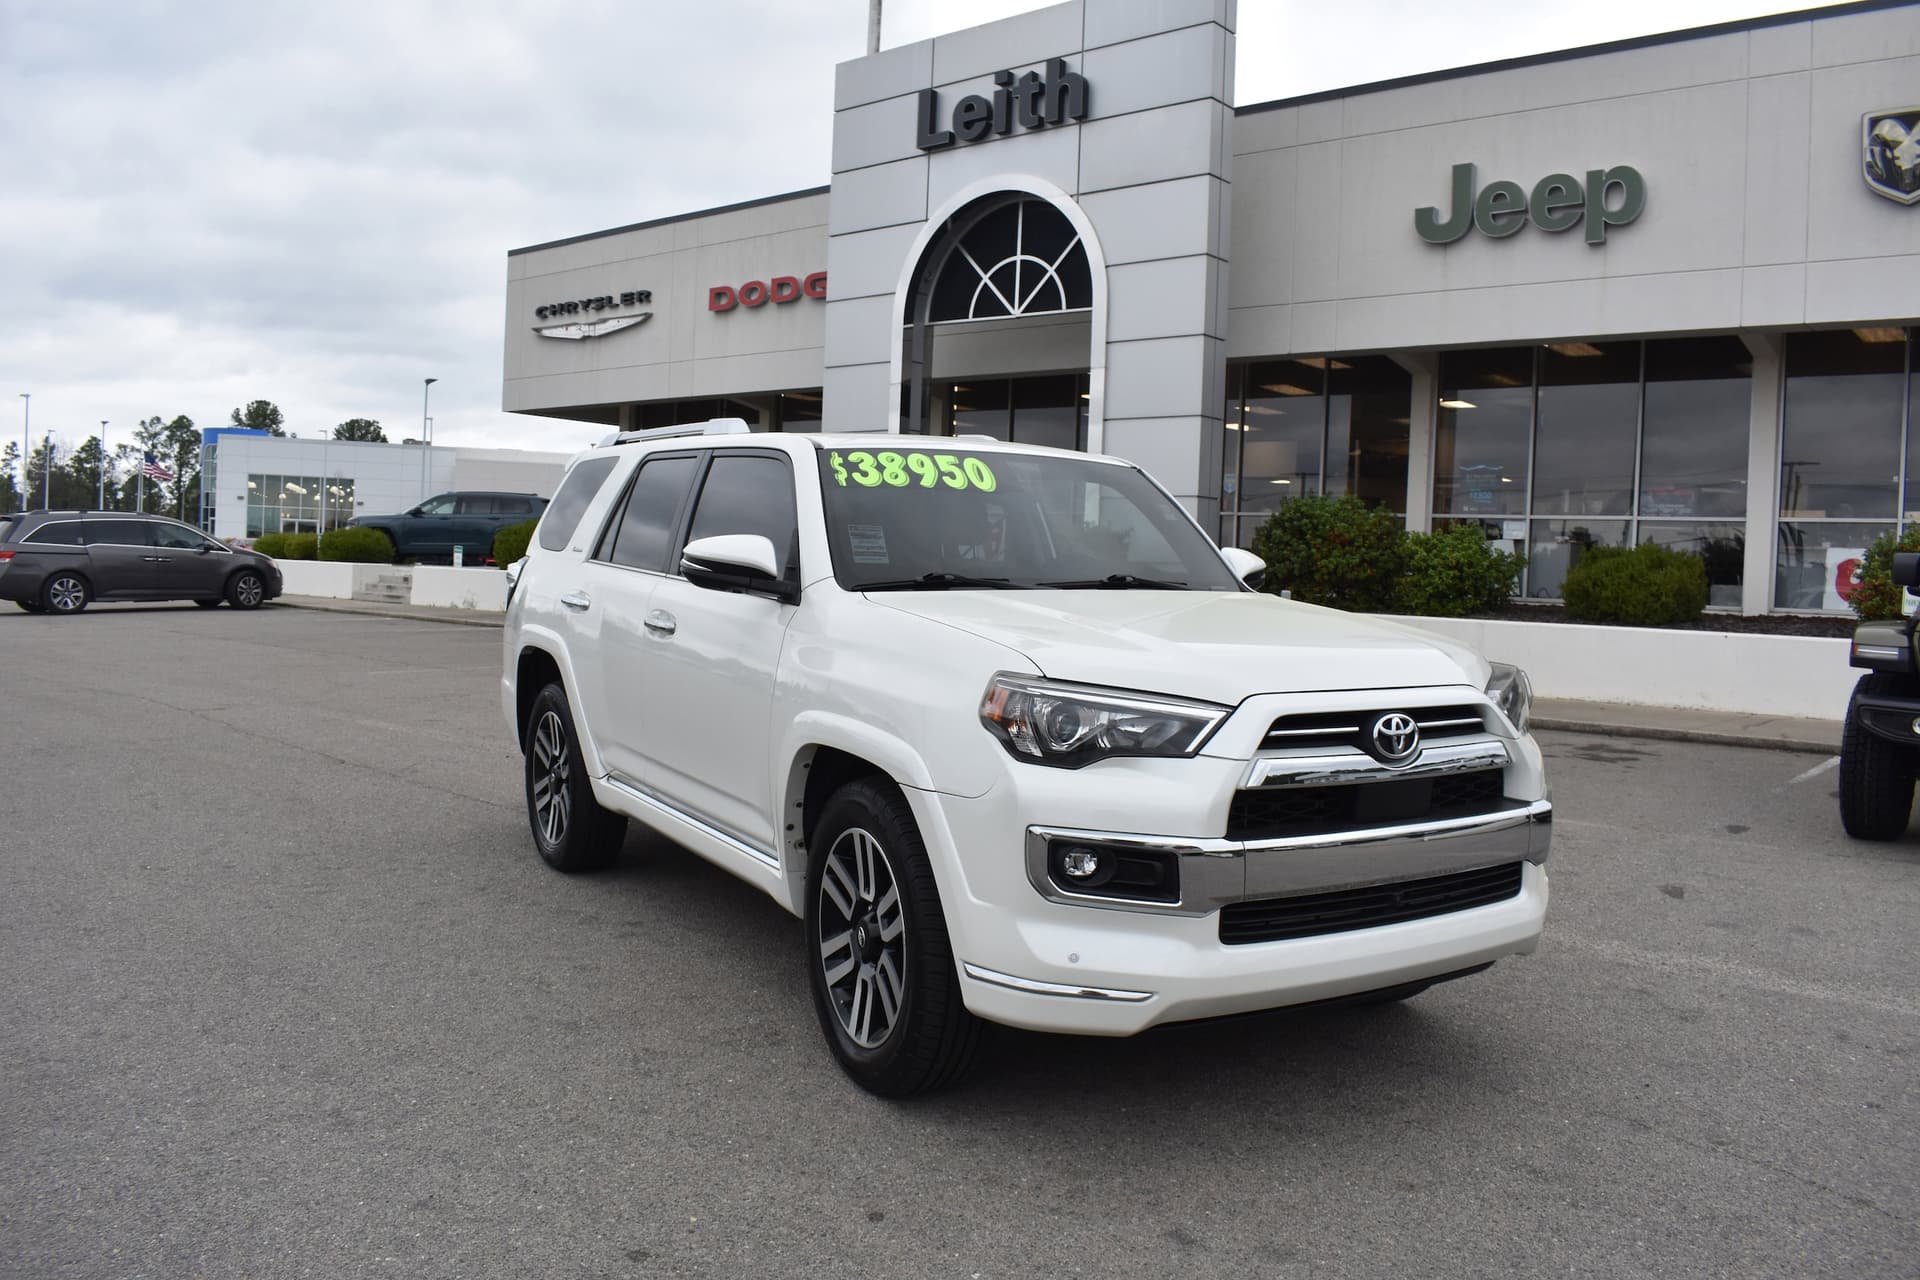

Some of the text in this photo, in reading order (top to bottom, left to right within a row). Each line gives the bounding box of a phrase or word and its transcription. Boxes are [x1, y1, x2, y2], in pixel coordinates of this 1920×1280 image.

[917, 57, 1089, 151] Leith
[1415, 162, 1648, 245] Jeep
[536, 290, 652, 319] CHRYSLER
[831, 451, 997, 493] $38950
